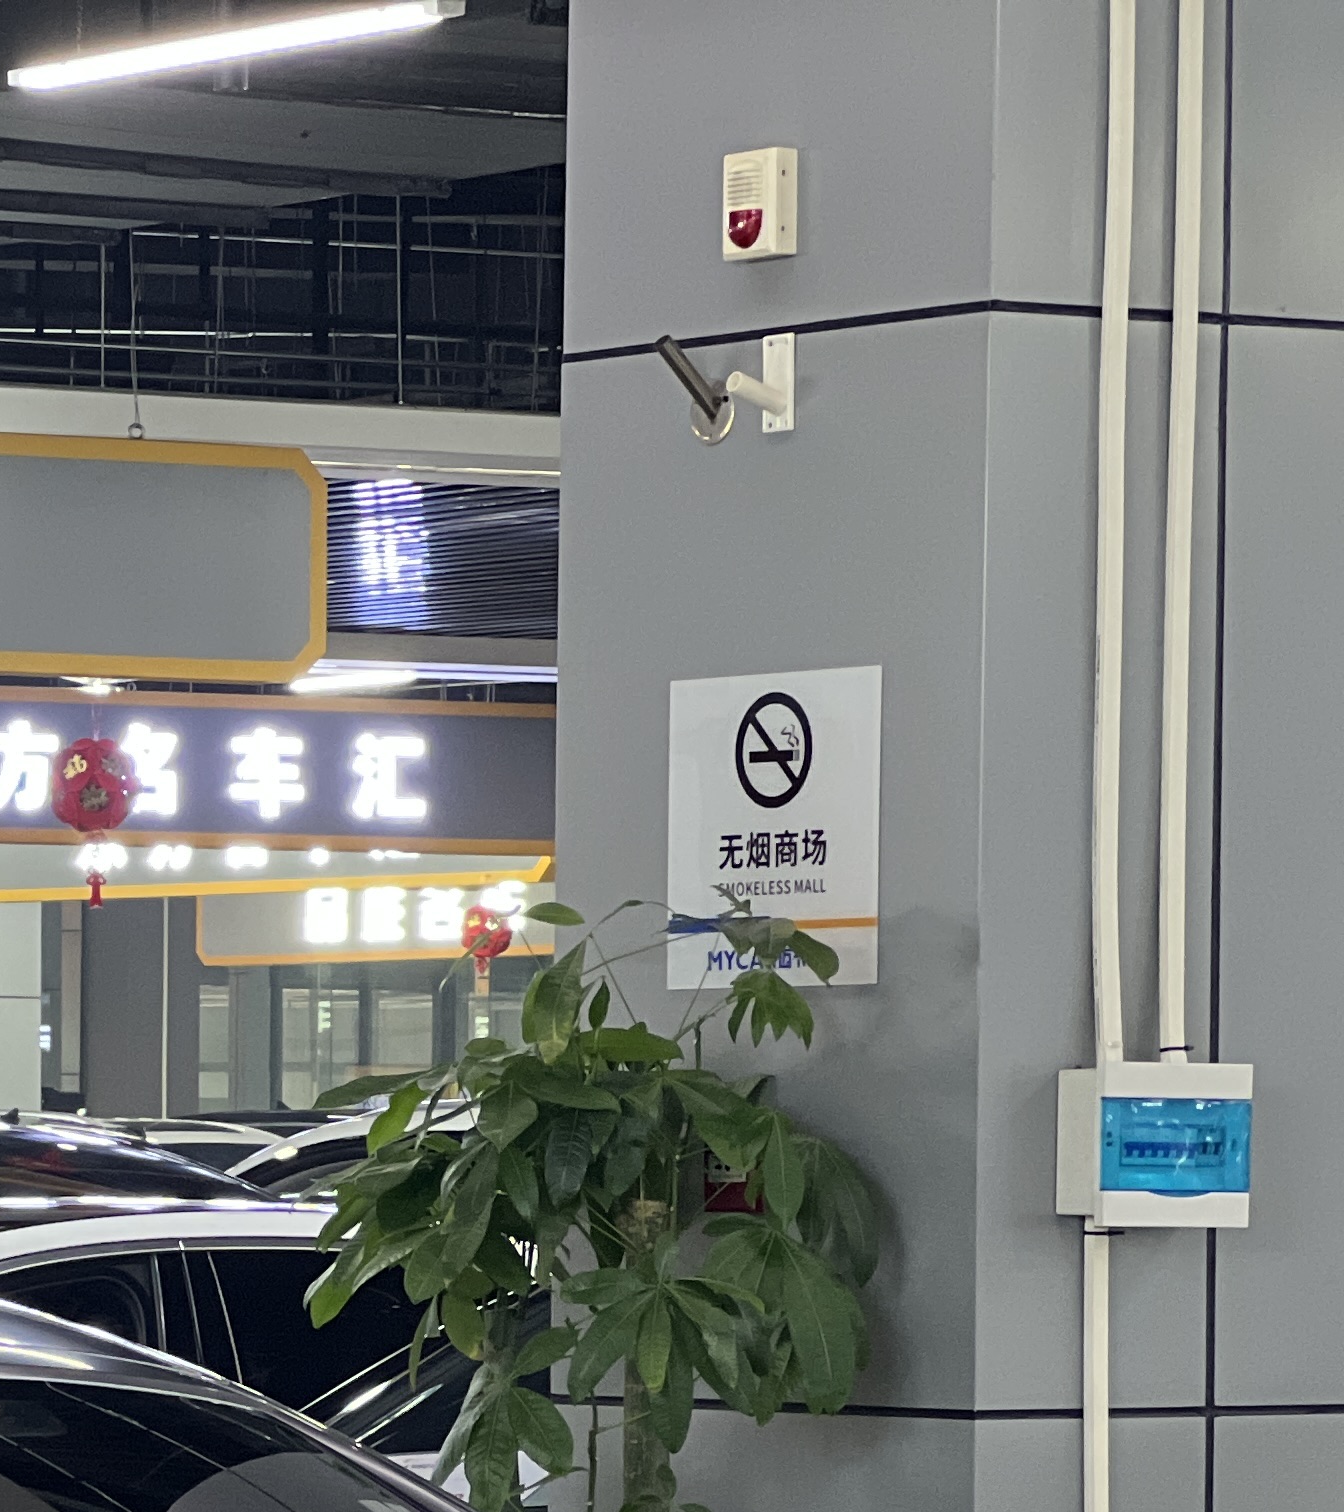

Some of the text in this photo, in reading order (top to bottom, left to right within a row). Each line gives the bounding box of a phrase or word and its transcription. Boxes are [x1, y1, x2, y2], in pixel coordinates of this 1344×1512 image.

[719, 829, 827, 869] 无烟商场
[718, 878, 826, 897] SMOKELESS MALL
